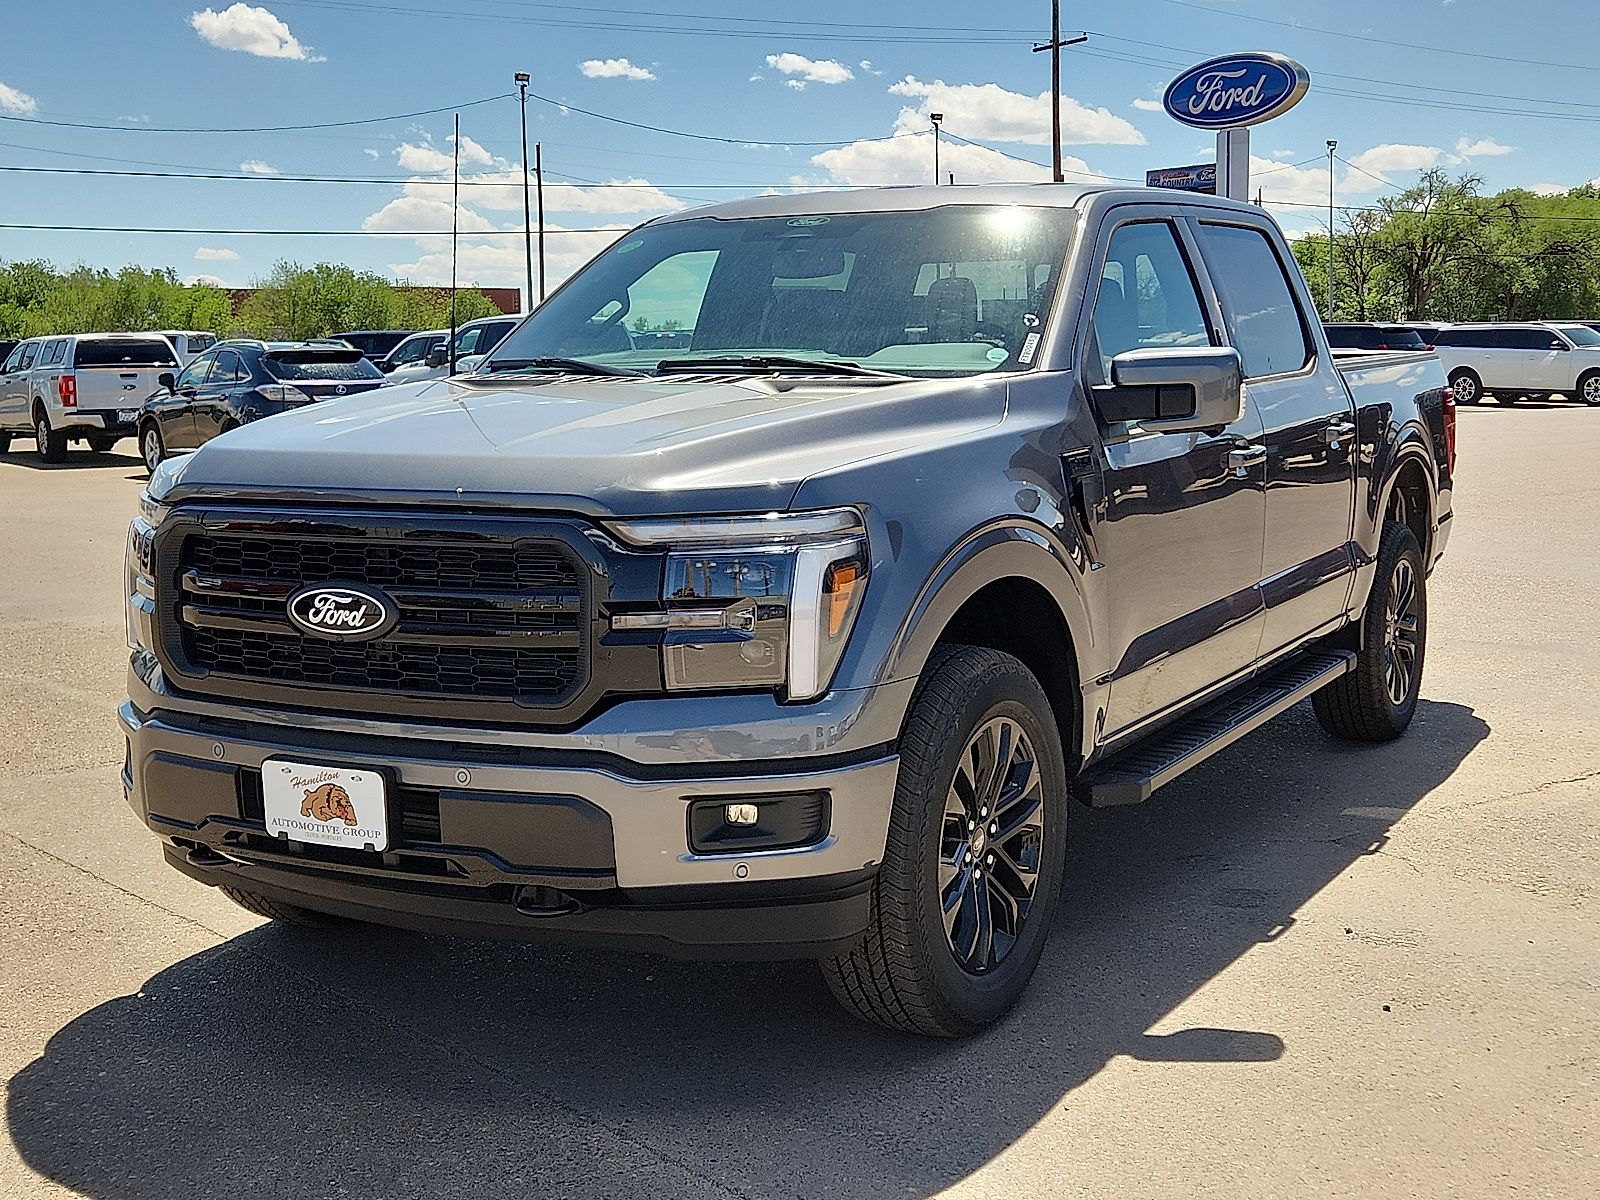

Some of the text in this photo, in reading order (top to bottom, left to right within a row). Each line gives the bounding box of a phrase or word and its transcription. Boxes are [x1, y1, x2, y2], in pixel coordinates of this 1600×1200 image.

[1189, 68, 1267, 114] Ford
[308, 594, 367, 627] Ford
[290, 771, 340, 789] Hamilton
[271, 817, 382, 839] AUTOMOTIVE GROUP
